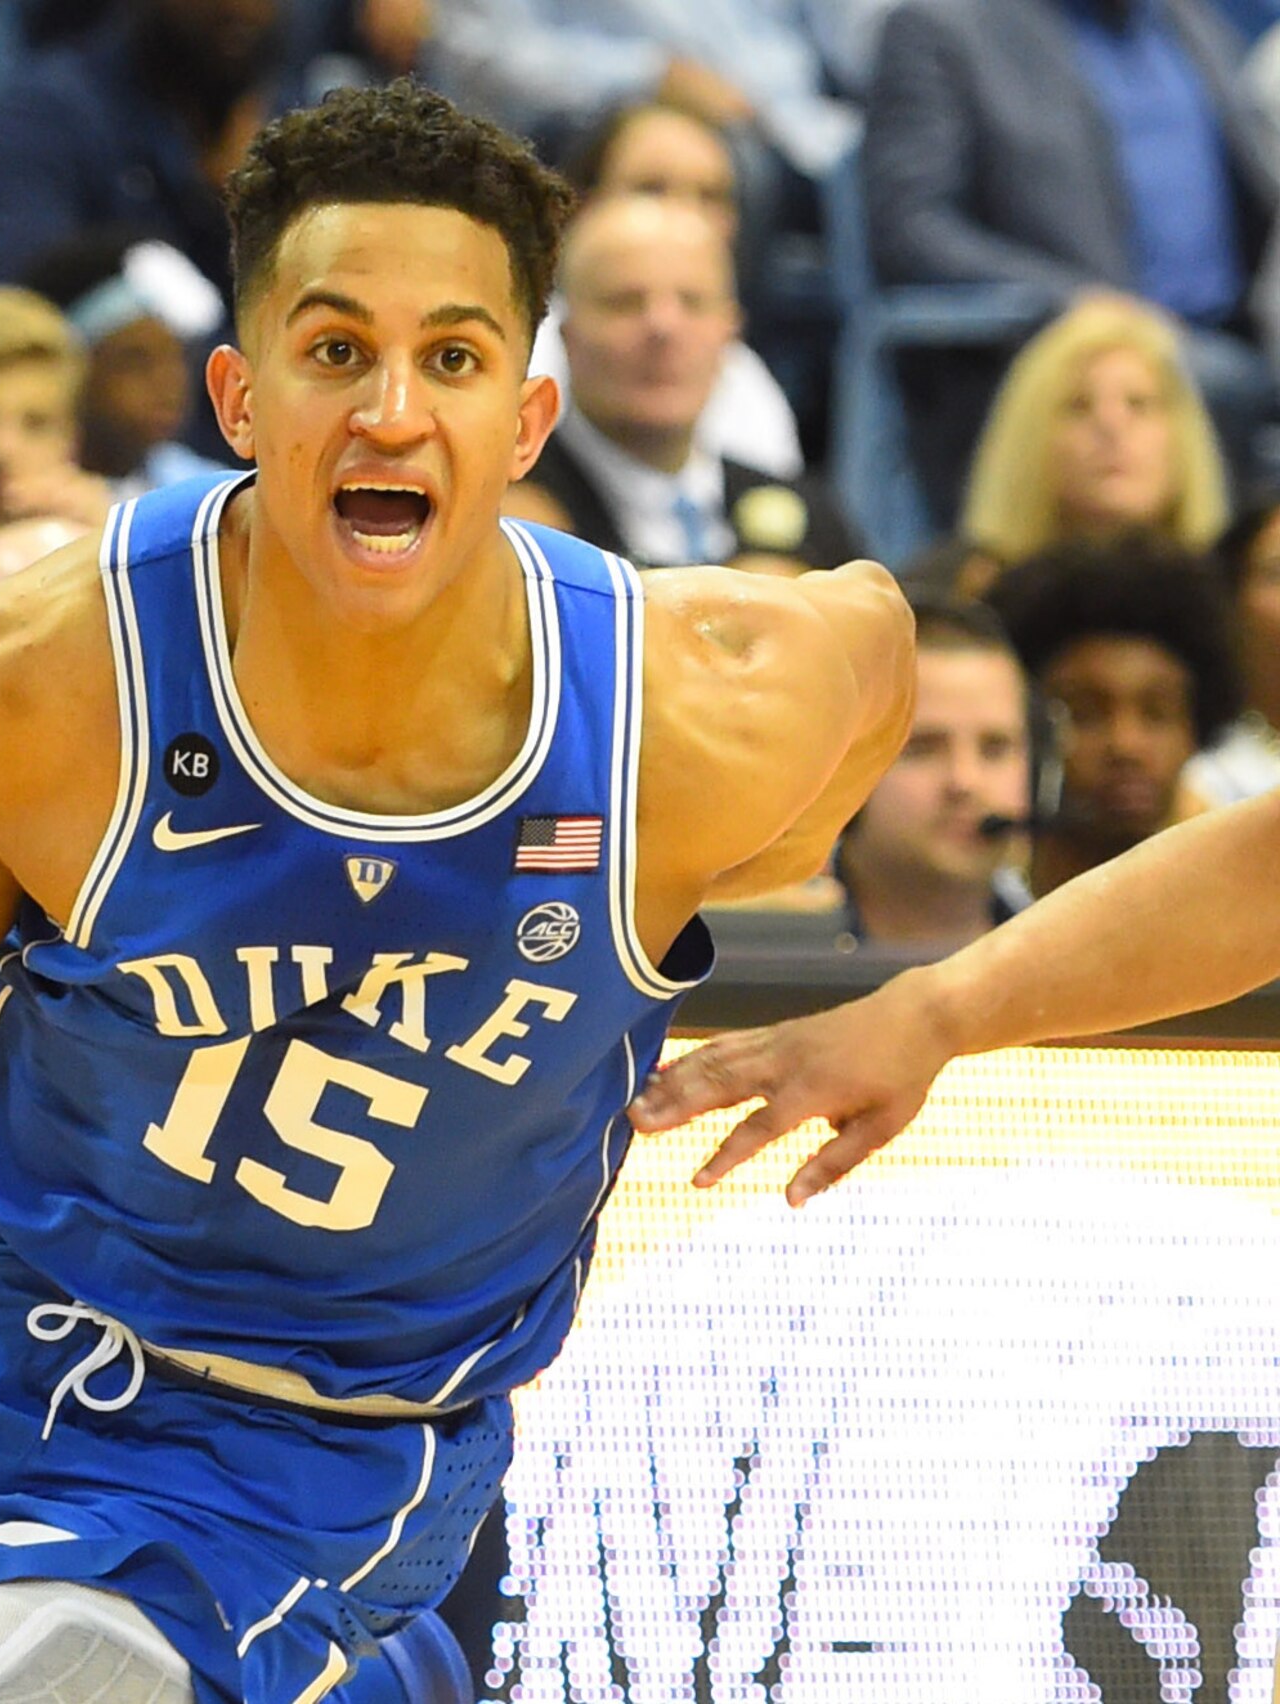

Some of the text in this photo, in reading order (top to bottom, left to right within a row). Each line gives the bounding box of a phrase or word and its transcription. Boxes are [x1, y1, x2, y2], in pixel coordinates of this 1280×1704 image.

[172, 749, 209, 778] KB
[526, 921, 578, 938] ACC
[117, 946, 577, 1086] DUKE
[142, 1034, 430, 1231] 15
